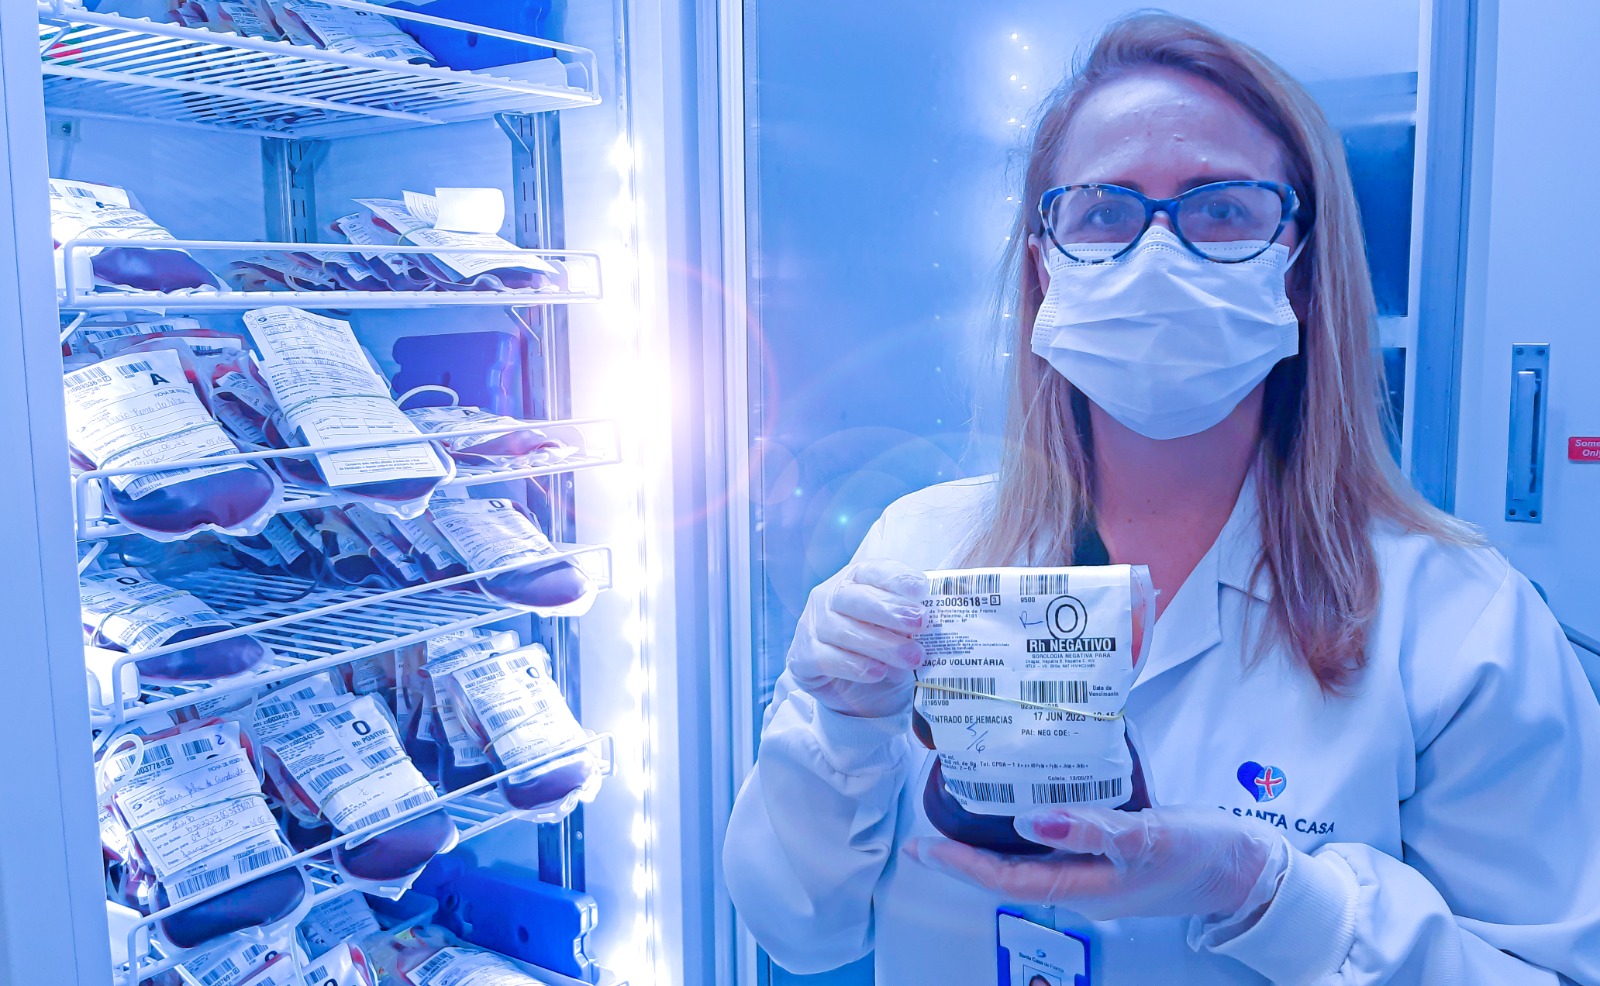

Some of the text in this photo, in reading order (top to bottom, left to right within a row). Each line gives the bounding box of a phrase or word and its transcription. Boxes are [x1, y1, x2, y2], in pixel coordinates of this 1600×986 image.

[150, 373, 171, 386] A
[116, 577, 139, 585] O
[1046, 595, 1088, 639] O
[1029, 637, 1112, 652] Rh NEGATIVO
[949, 657, 1005, 666] VOLUNTÁRIA
[964, 715, 974, 723] DE
[975, 715, 1013, 724] HEMACIAS
[1033, 711, 1043, 721] 17
[1045, 712, 1063, 721] JUN
[352, 720, 371, 736] O
[362, 728, 390, 744] POSITIVO
[1294, 818, 1335, 835] CASA
